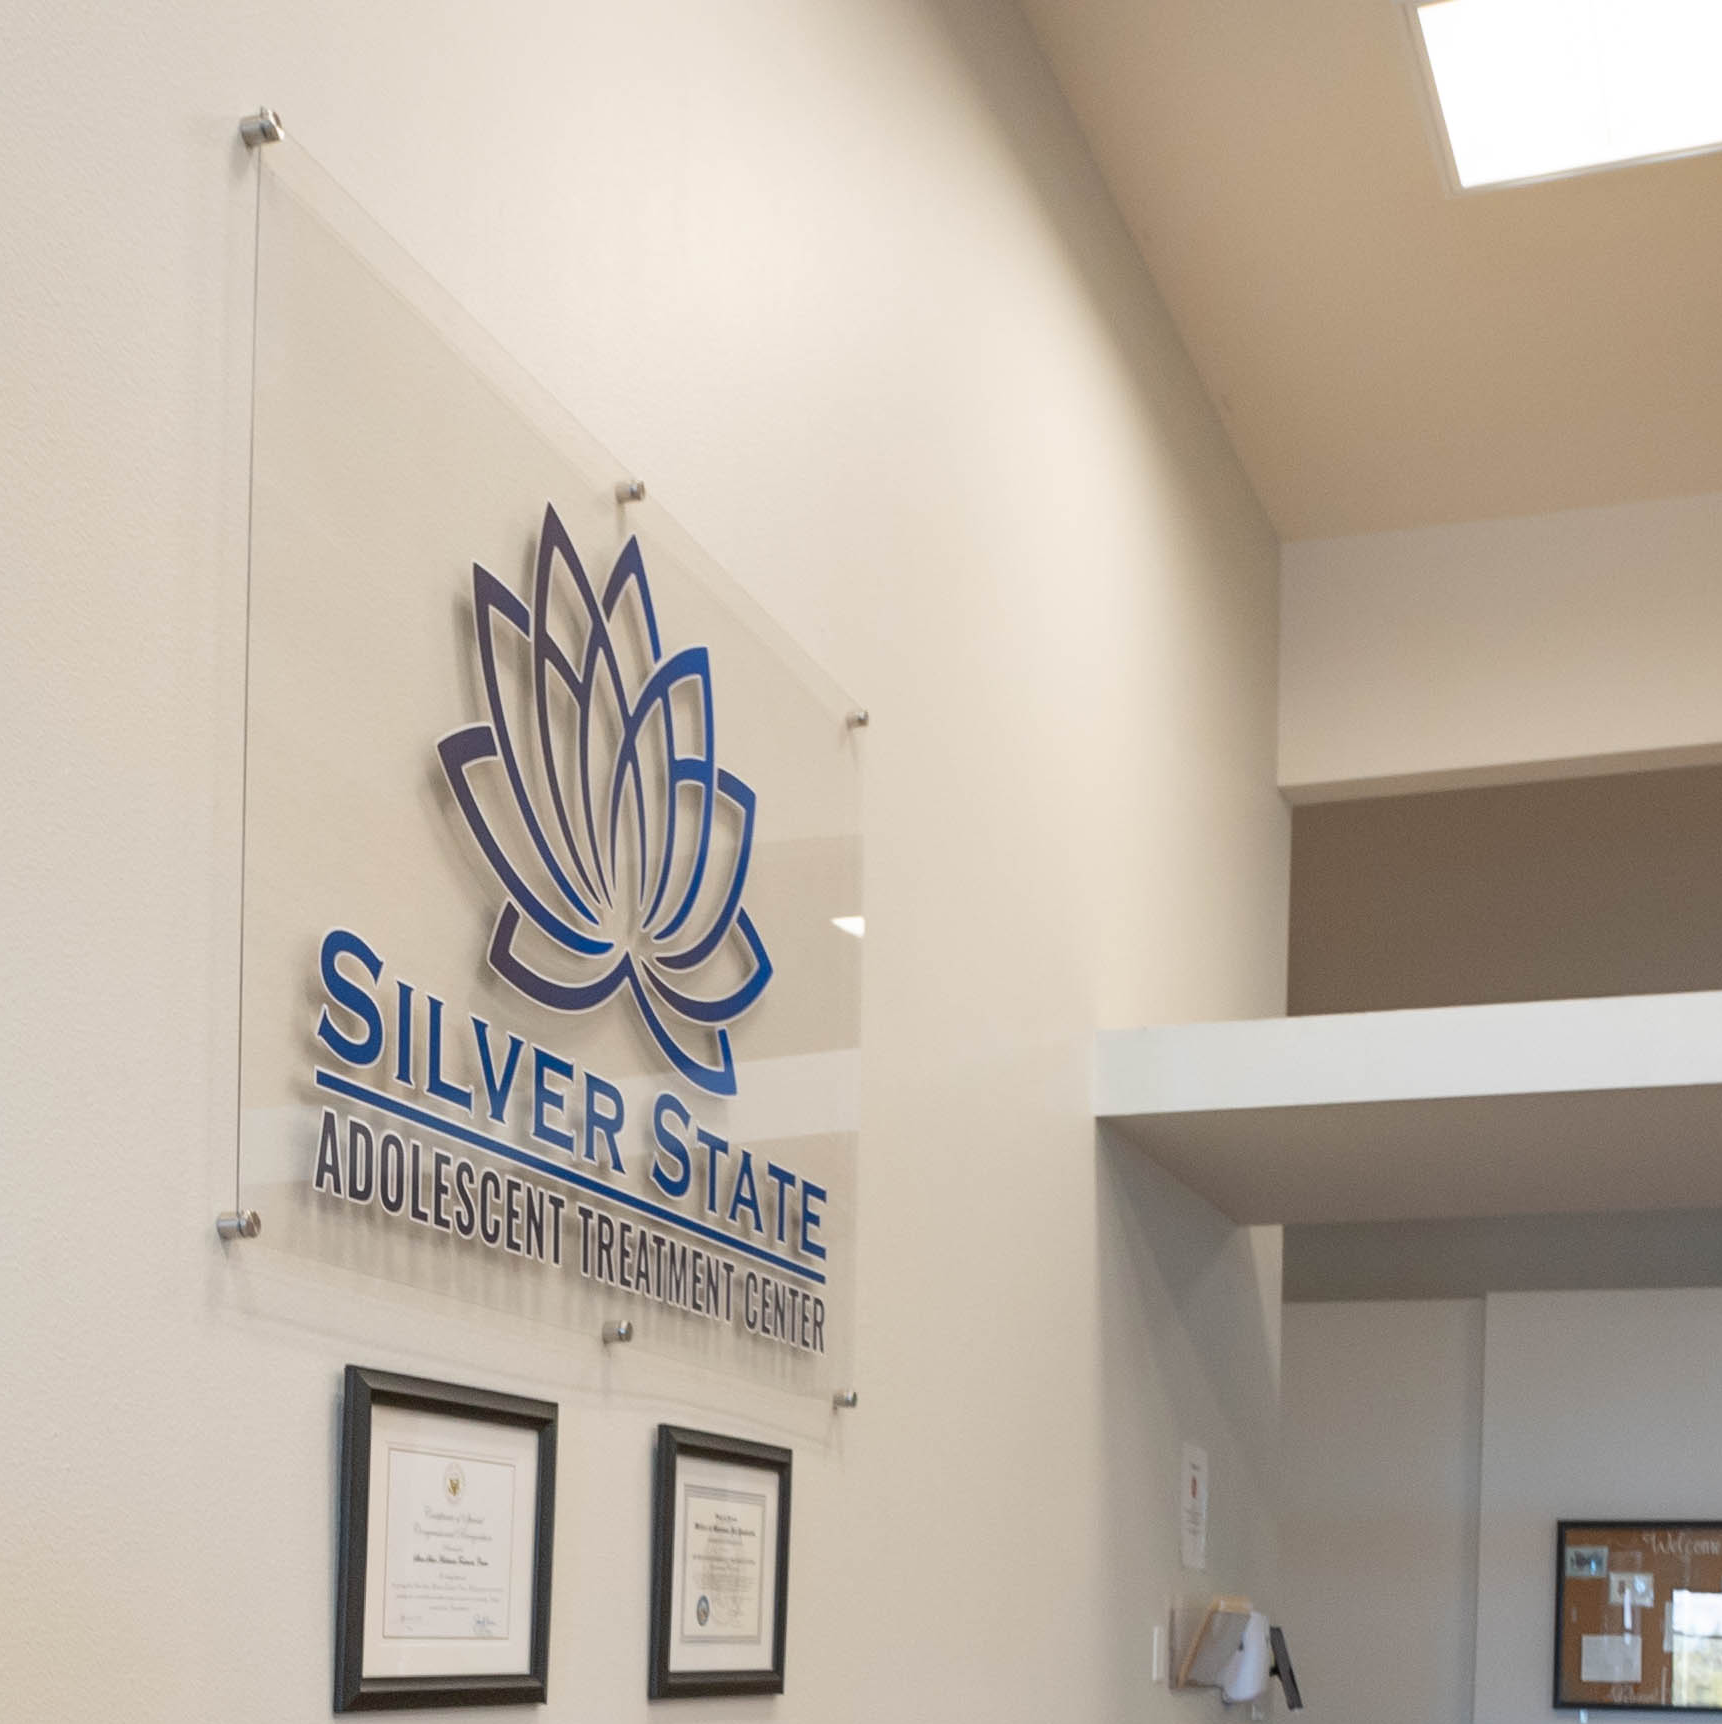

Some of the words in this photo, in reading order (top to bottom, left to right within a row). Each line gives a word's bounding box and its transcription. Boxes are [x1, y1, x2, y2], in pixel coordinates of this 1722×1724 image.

[313, 1108, 565, 1265] ADOLESCENT
[577, 1205, 735, 1323] TREATMENT
[744, 1270, 826, 1354] CENTER
[316, 927, 626, 1175] SILVER
[649, 1093, 828, 1261] STATE
